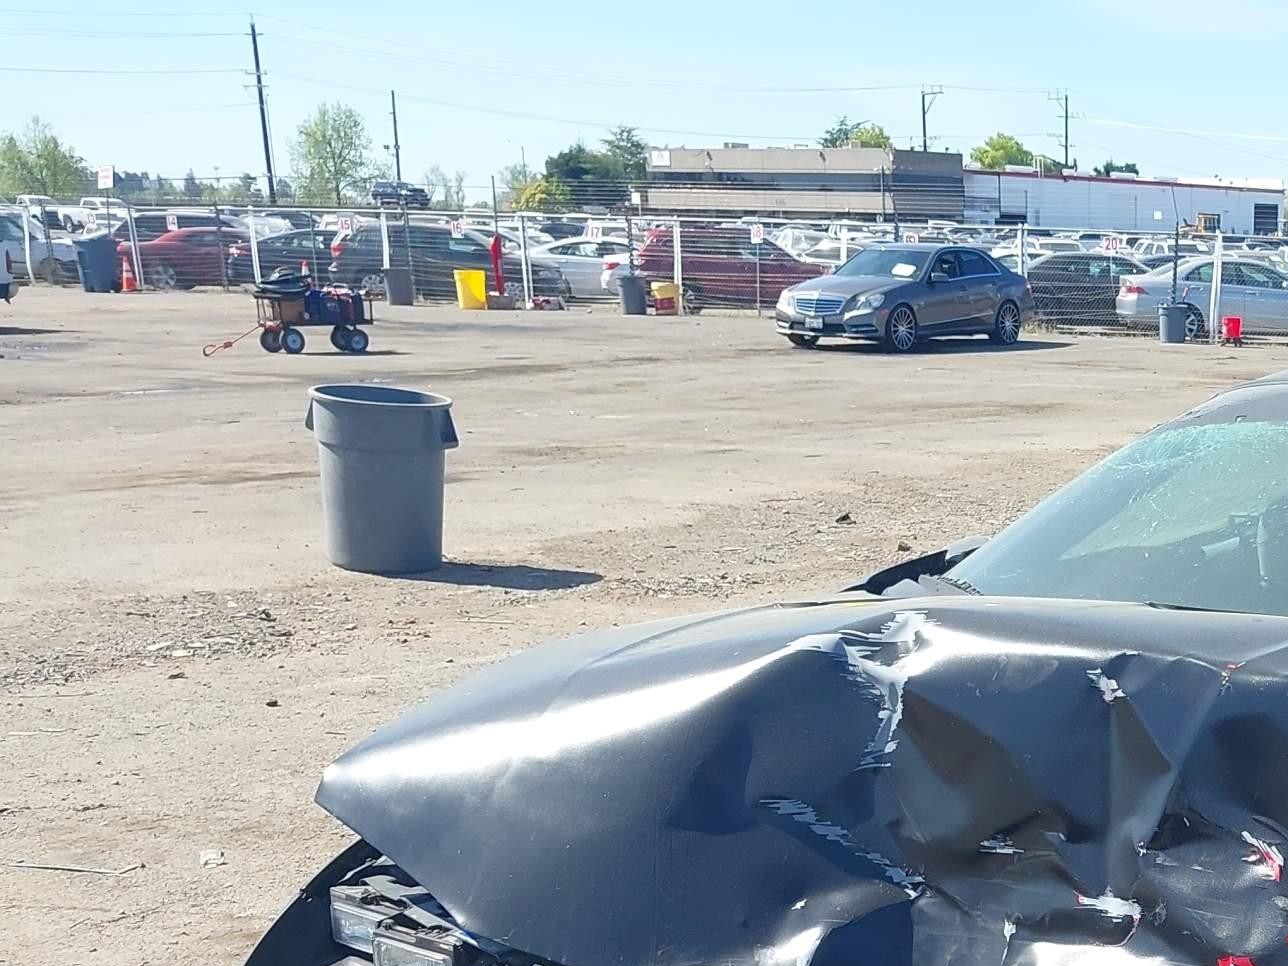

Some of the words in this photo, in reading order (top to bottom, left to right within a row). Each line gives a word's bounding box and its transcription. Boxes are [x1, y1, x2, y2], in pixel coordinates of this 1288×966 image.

[340, 219, 350, 230] 15
[452, 221, 463, 234] 16
[591, 226, 600, 239] 17
[1104, 236, 1118, 250] 20
